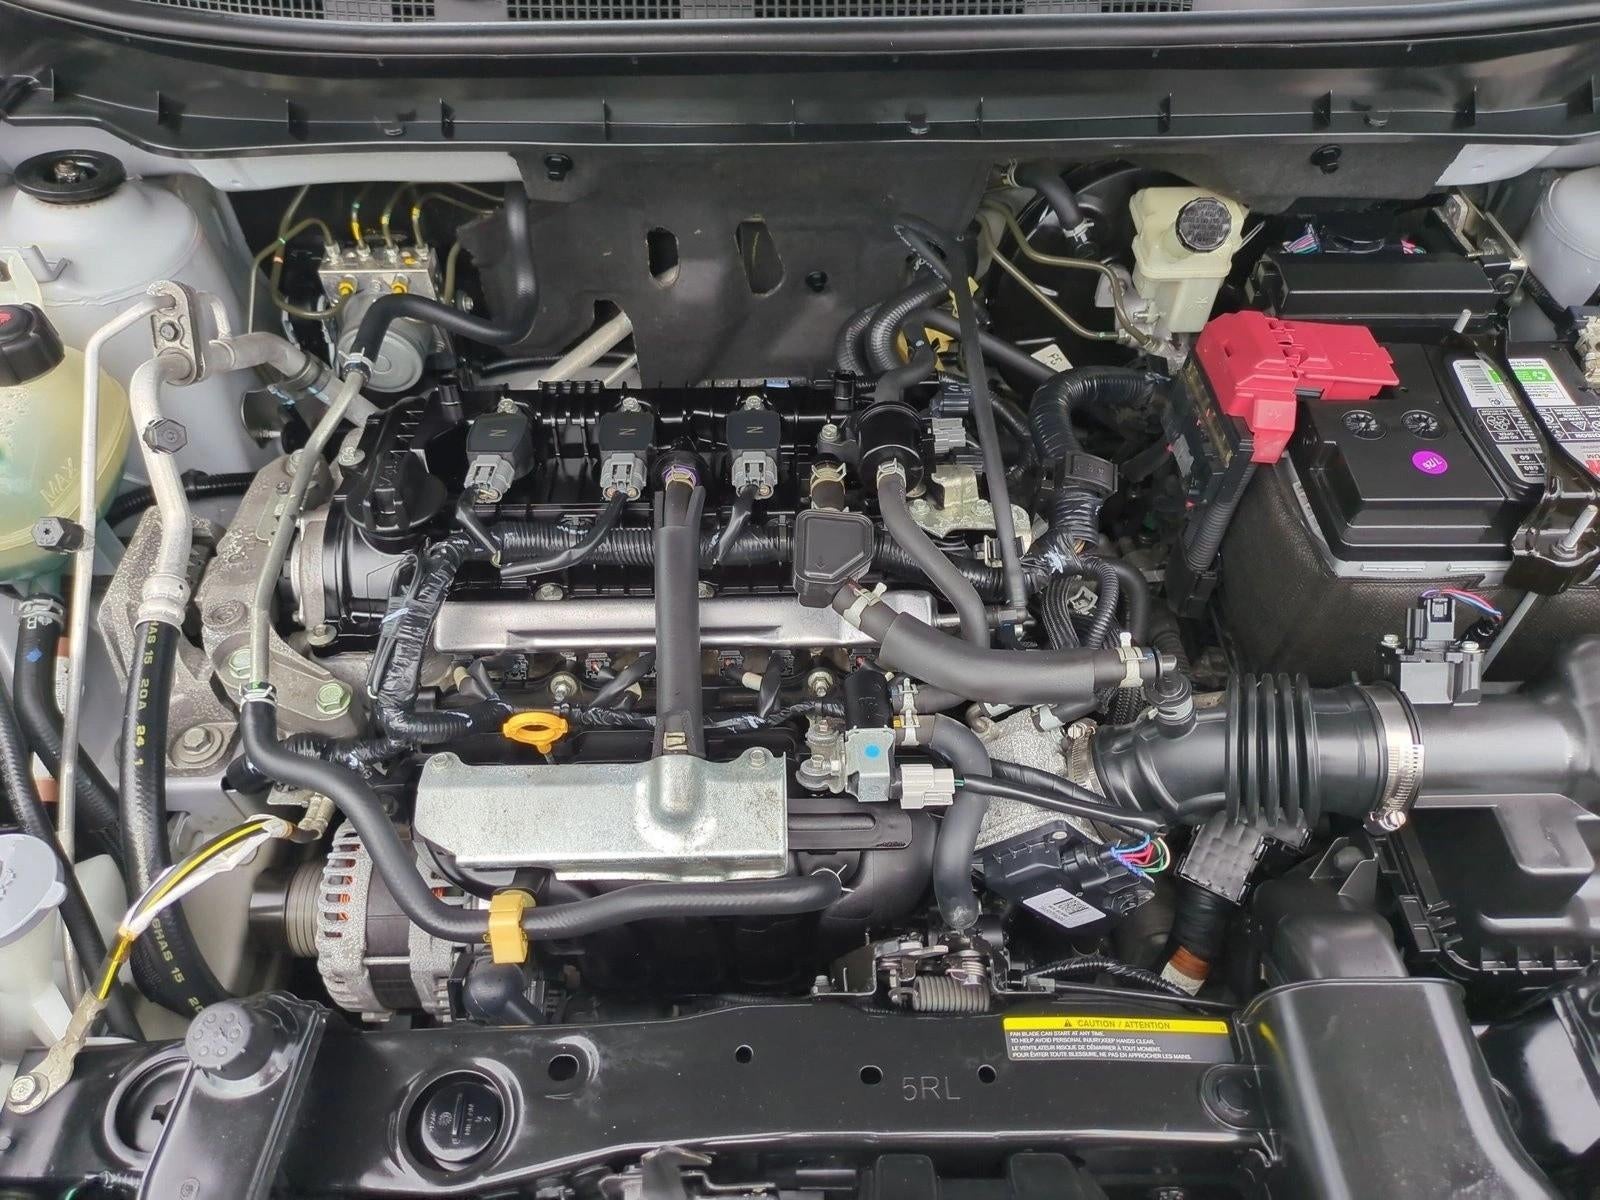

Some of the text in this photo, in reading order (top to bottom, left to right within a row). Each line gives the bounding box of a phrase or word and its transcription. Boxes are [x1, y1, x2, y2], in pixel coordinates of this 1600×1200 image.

[143, 650, 154, 664] 15
[135, 725, 146, 747] 24
[171, 967, 185, 983] 15
[1077, 1019, 1115, 1028] CAUTION
[1124, 1021, 1170, 1030] ATTENTION
[903, 1076, 961, 1101] 5RL
